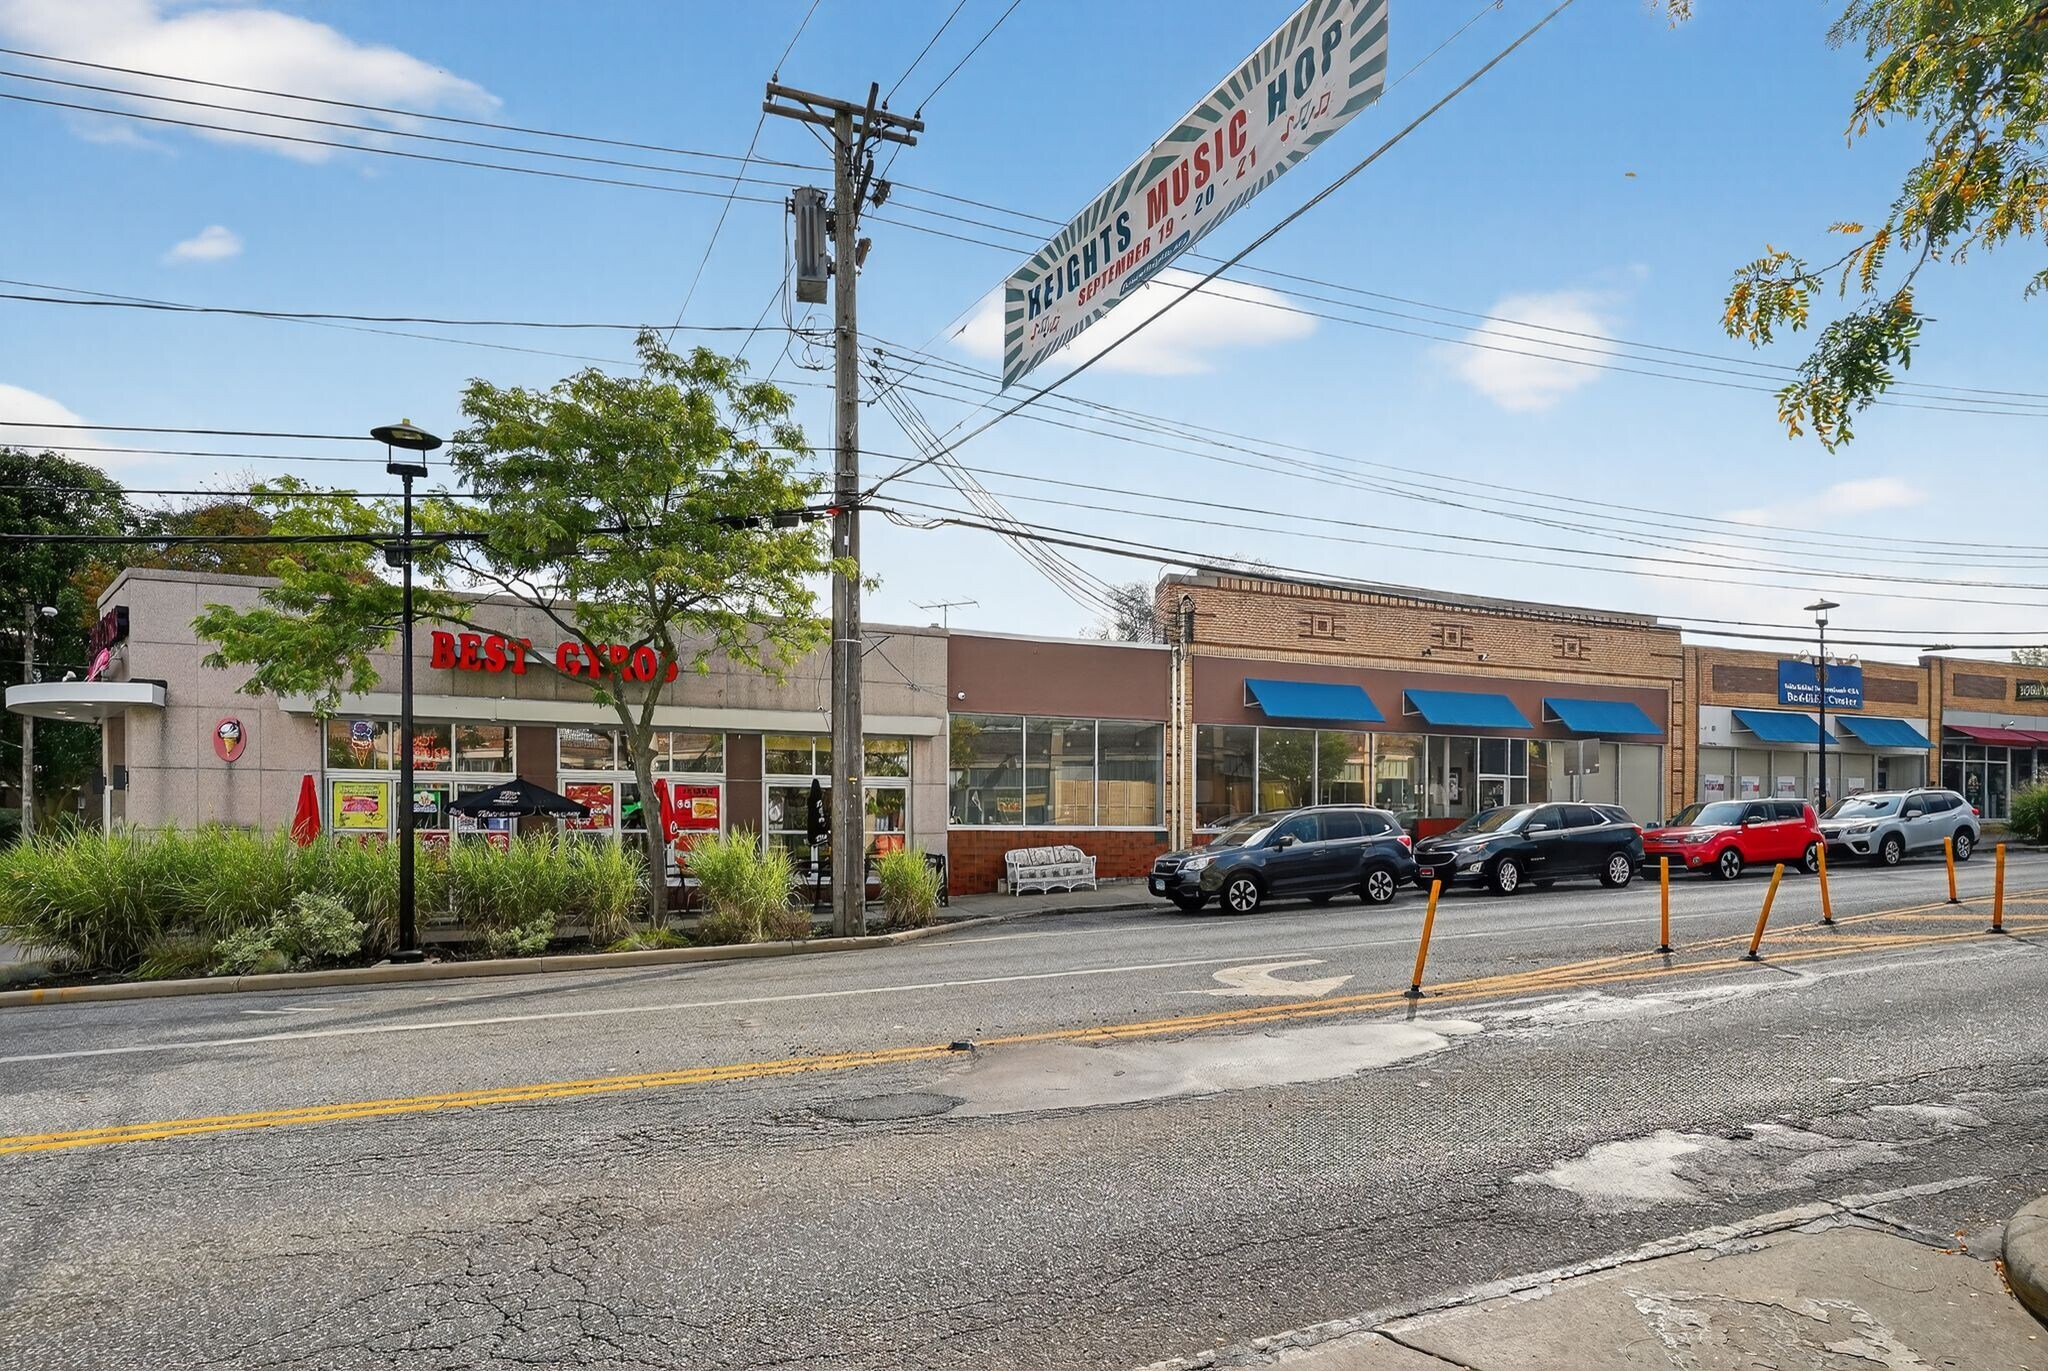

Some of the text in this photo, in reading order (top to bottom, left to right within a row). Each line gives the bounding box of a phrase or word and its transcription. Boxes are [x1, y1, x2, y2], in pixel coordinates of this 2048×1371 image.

[1028, 211, 1131, 321] HEIGHTS
[1146, 109, 1247, 230] MUSIC
[1267, 19, 1343, 126] HOP
[1078, 237, 1151, 307] SEPTEMBER
[1158, 217, 1174, 244] 19
[1194, 183, 1214, 216] 20
[1236, 145, 1257, 180] 21
[430, 631, 533, 675] BEST
